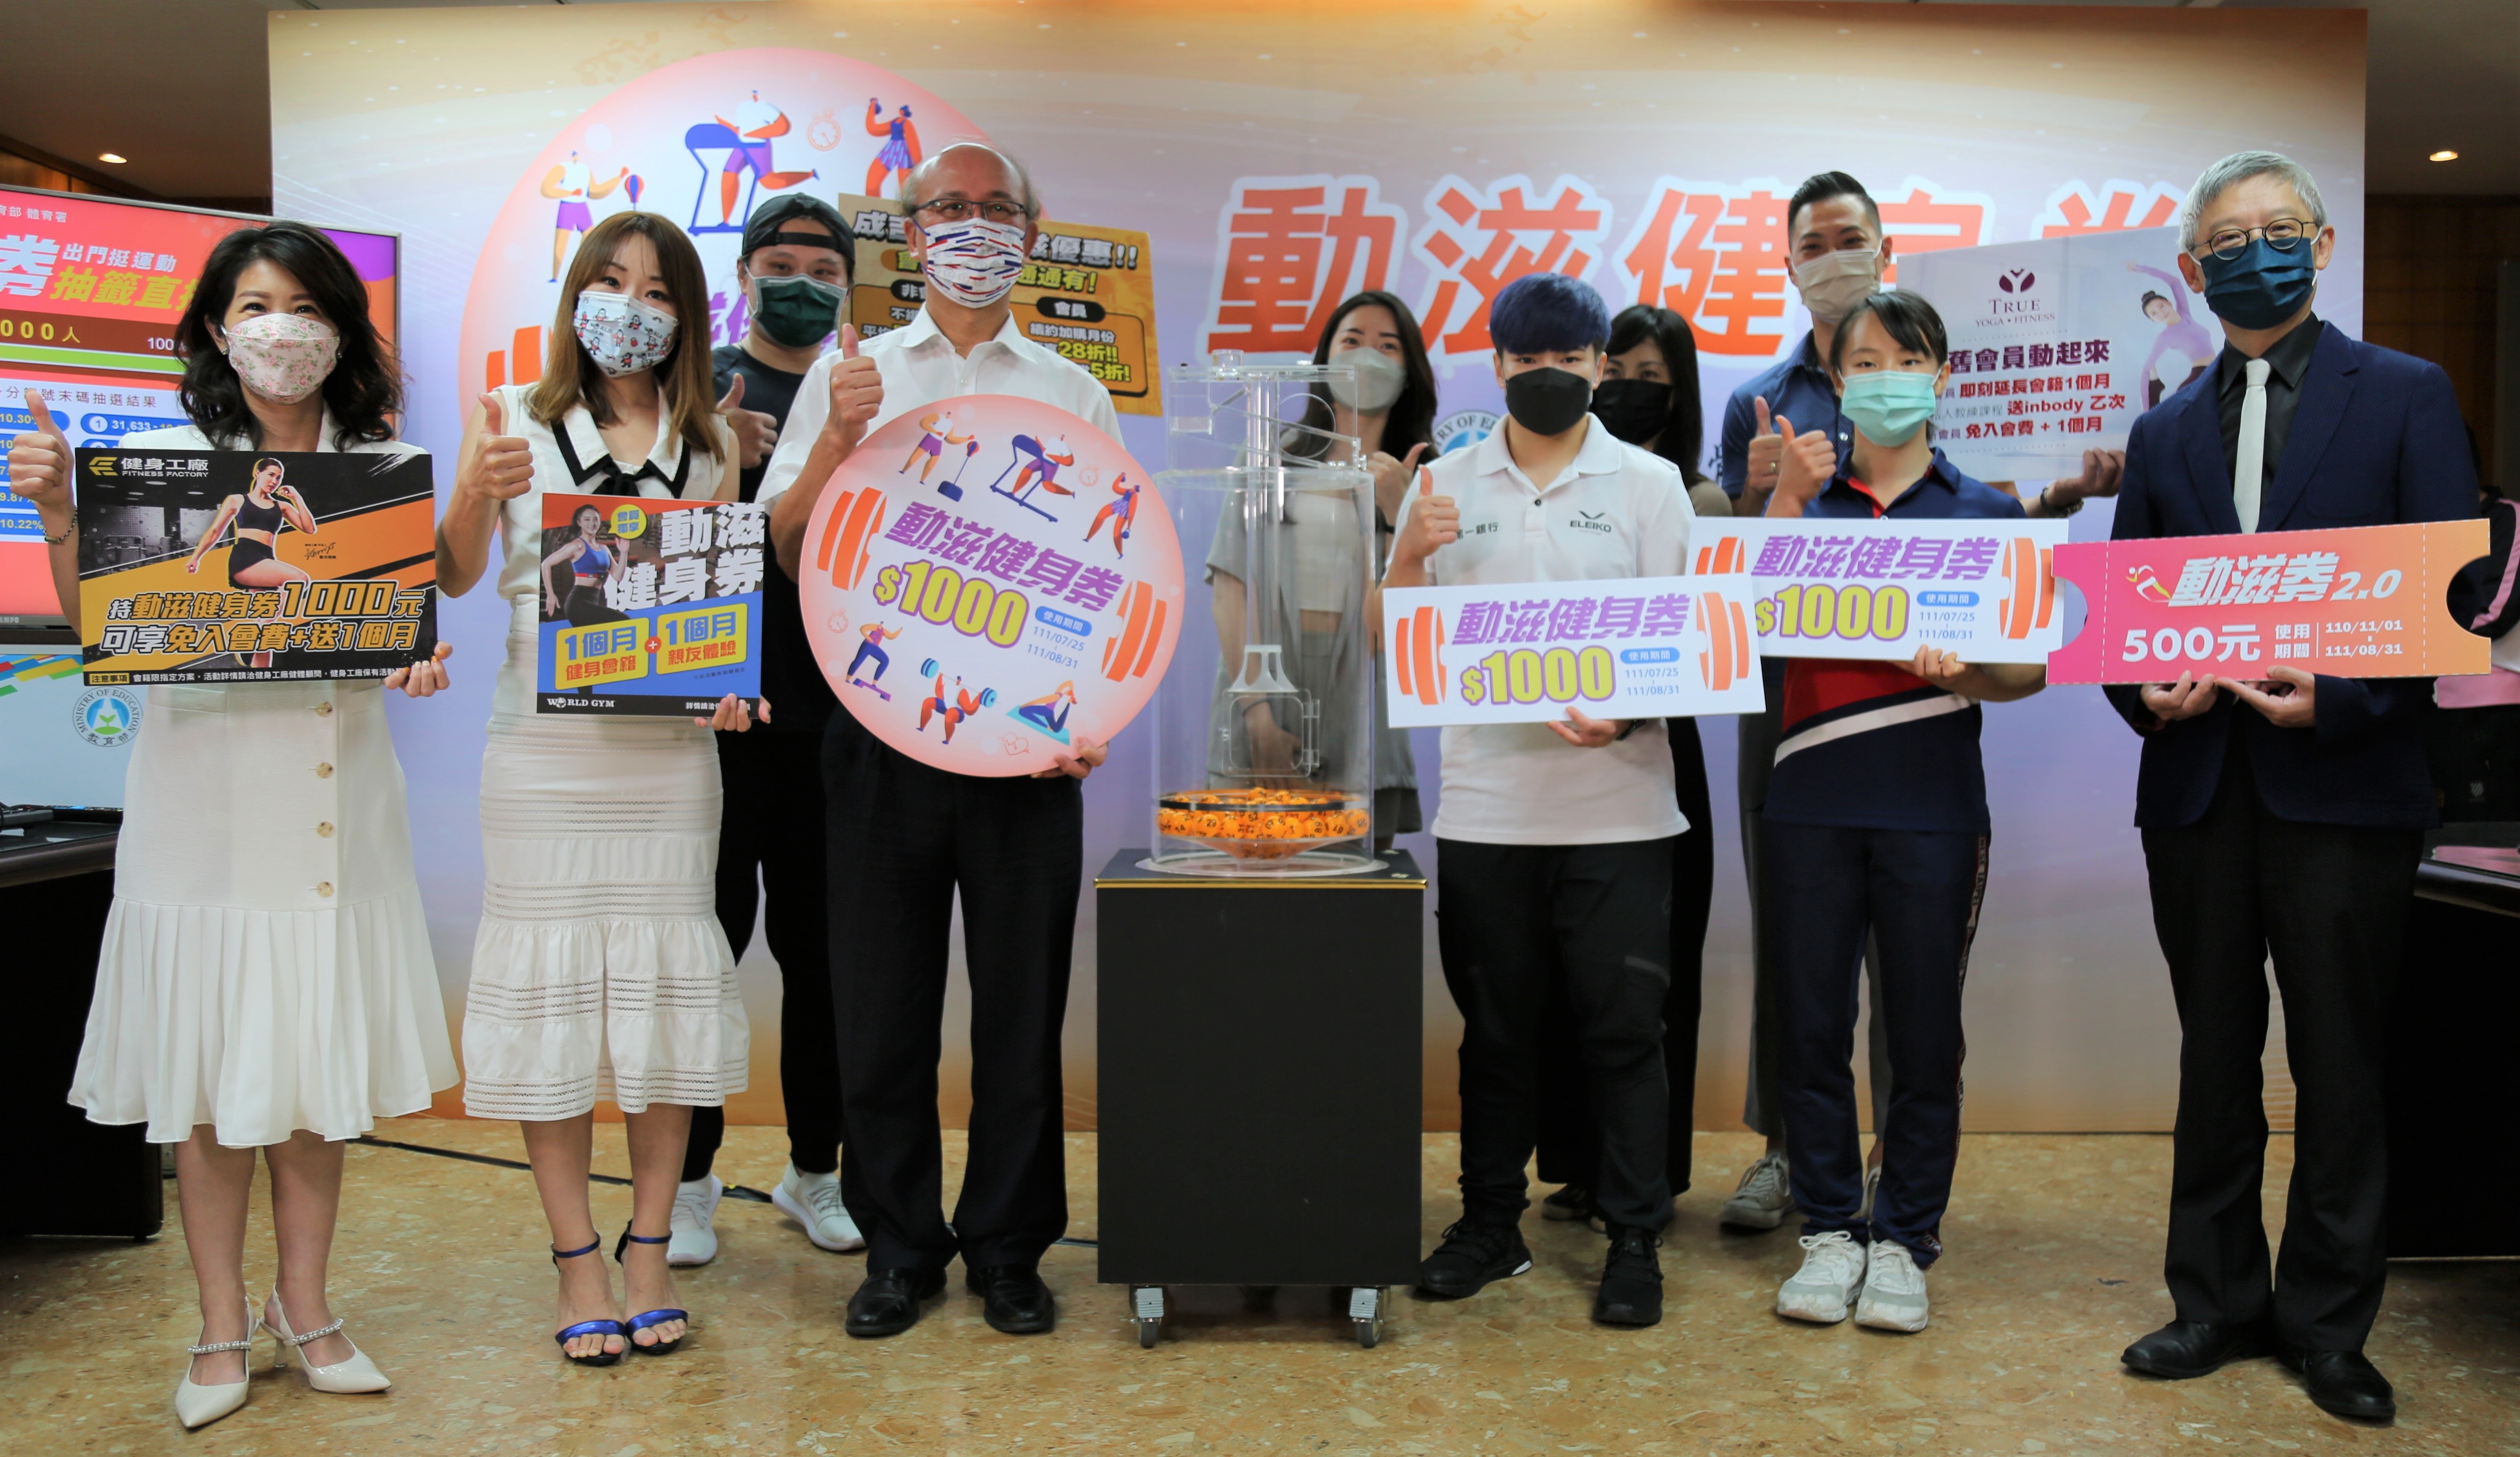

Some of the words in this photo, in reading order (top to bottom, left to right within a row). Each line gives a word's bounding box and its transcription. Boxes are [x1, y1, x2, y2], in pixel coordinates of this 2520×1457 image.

[27, 208, 67, 223] 體育署
[63, 243, 177, 273] 出門挺運動
[1054, 301, 1088, 318] 會員
[1989, 299, 2040, 315] TRUE
[1976, 318, 2004, 328] YOGA
[2015, 313, 2055, 325] FITNESS
[1960, 373, 2110, 398] 即刻延長會籍1個月
[1966, 420, 2034, 439] 免入會費
[2058, 416, 2102, 433] 1個月
[121, 457, 209, 471] 健身工廠
[660, 502, 765, 558] 動滋
[1570, 520, 1612, 533] ELEIKO
[884, 501, 1125, 612] 動滋健身券
[1751, 535, 2001, 580] 動滋健身券
[604, 548, 764, 612] 健身券
[872, 558, 1030, 649] $1000
[1926, 594, 1970, 604] 使用期間
[1043, 609, 1084, 632] 使用期間
[1452, 592, 1691, 645] 動滋健身券
[1755, 583, 1911, 641] $1000
[1919, 611, 1976, 623] 111/07/25
[565, 625, 637, 660] 1個月
[665, 611, 736, 646] 1個月
[1033, 625, 1085, 652] 111/07/25
[1918, 628, 1973, 640] 111/08/31
[2274, 623, 2311, 640] 使用
[2325, 620, 2403, 634] 110/11/01
[668, 640, 737, 665] 親友體驗
[2122, 623, 2261, 663] 500元
[2274, 643, 2311, 659] 期間
[2325, 643, 2403, 657] 111/08/31
[1027, 643, 1079, 669] 111/08/31
[1629, 651, 1672, 661] 使用期間
[91, 675, 128, 683] 注意事項
[566, 656, 637, 681] 健身會籍
[1460, 645, 1617, 706] $1000
[1625, 667, 1680, 679] 111/07/25
[1627, 685, 1680, 696] 111/08/31
[88, 732, 129, 746] 教育部
